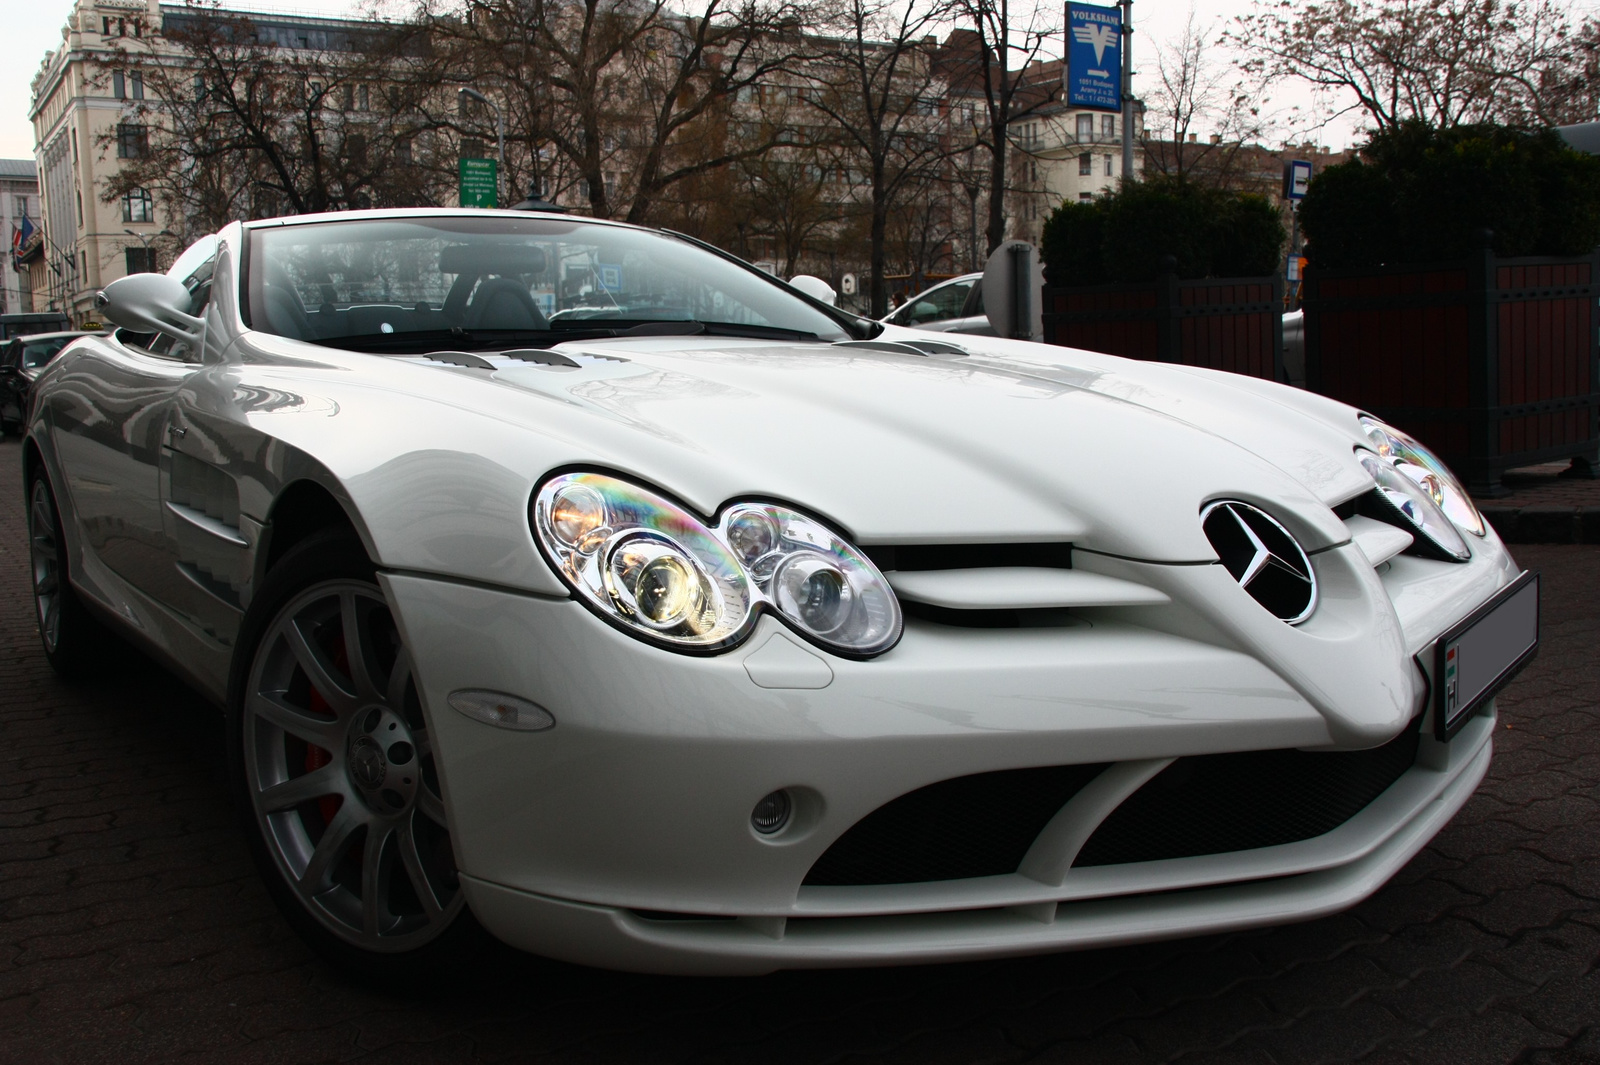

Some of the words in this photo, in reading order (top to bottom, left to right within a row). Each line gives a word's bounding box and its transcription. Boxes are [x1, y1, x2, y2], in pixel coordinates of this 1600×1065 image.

[1072, 11, 1119, 26] VOLKSBANK
[1080, 86, 1097, 95] Arany
[476, 194, 482, 202] P
[1446, 679, 1456, 714] H
